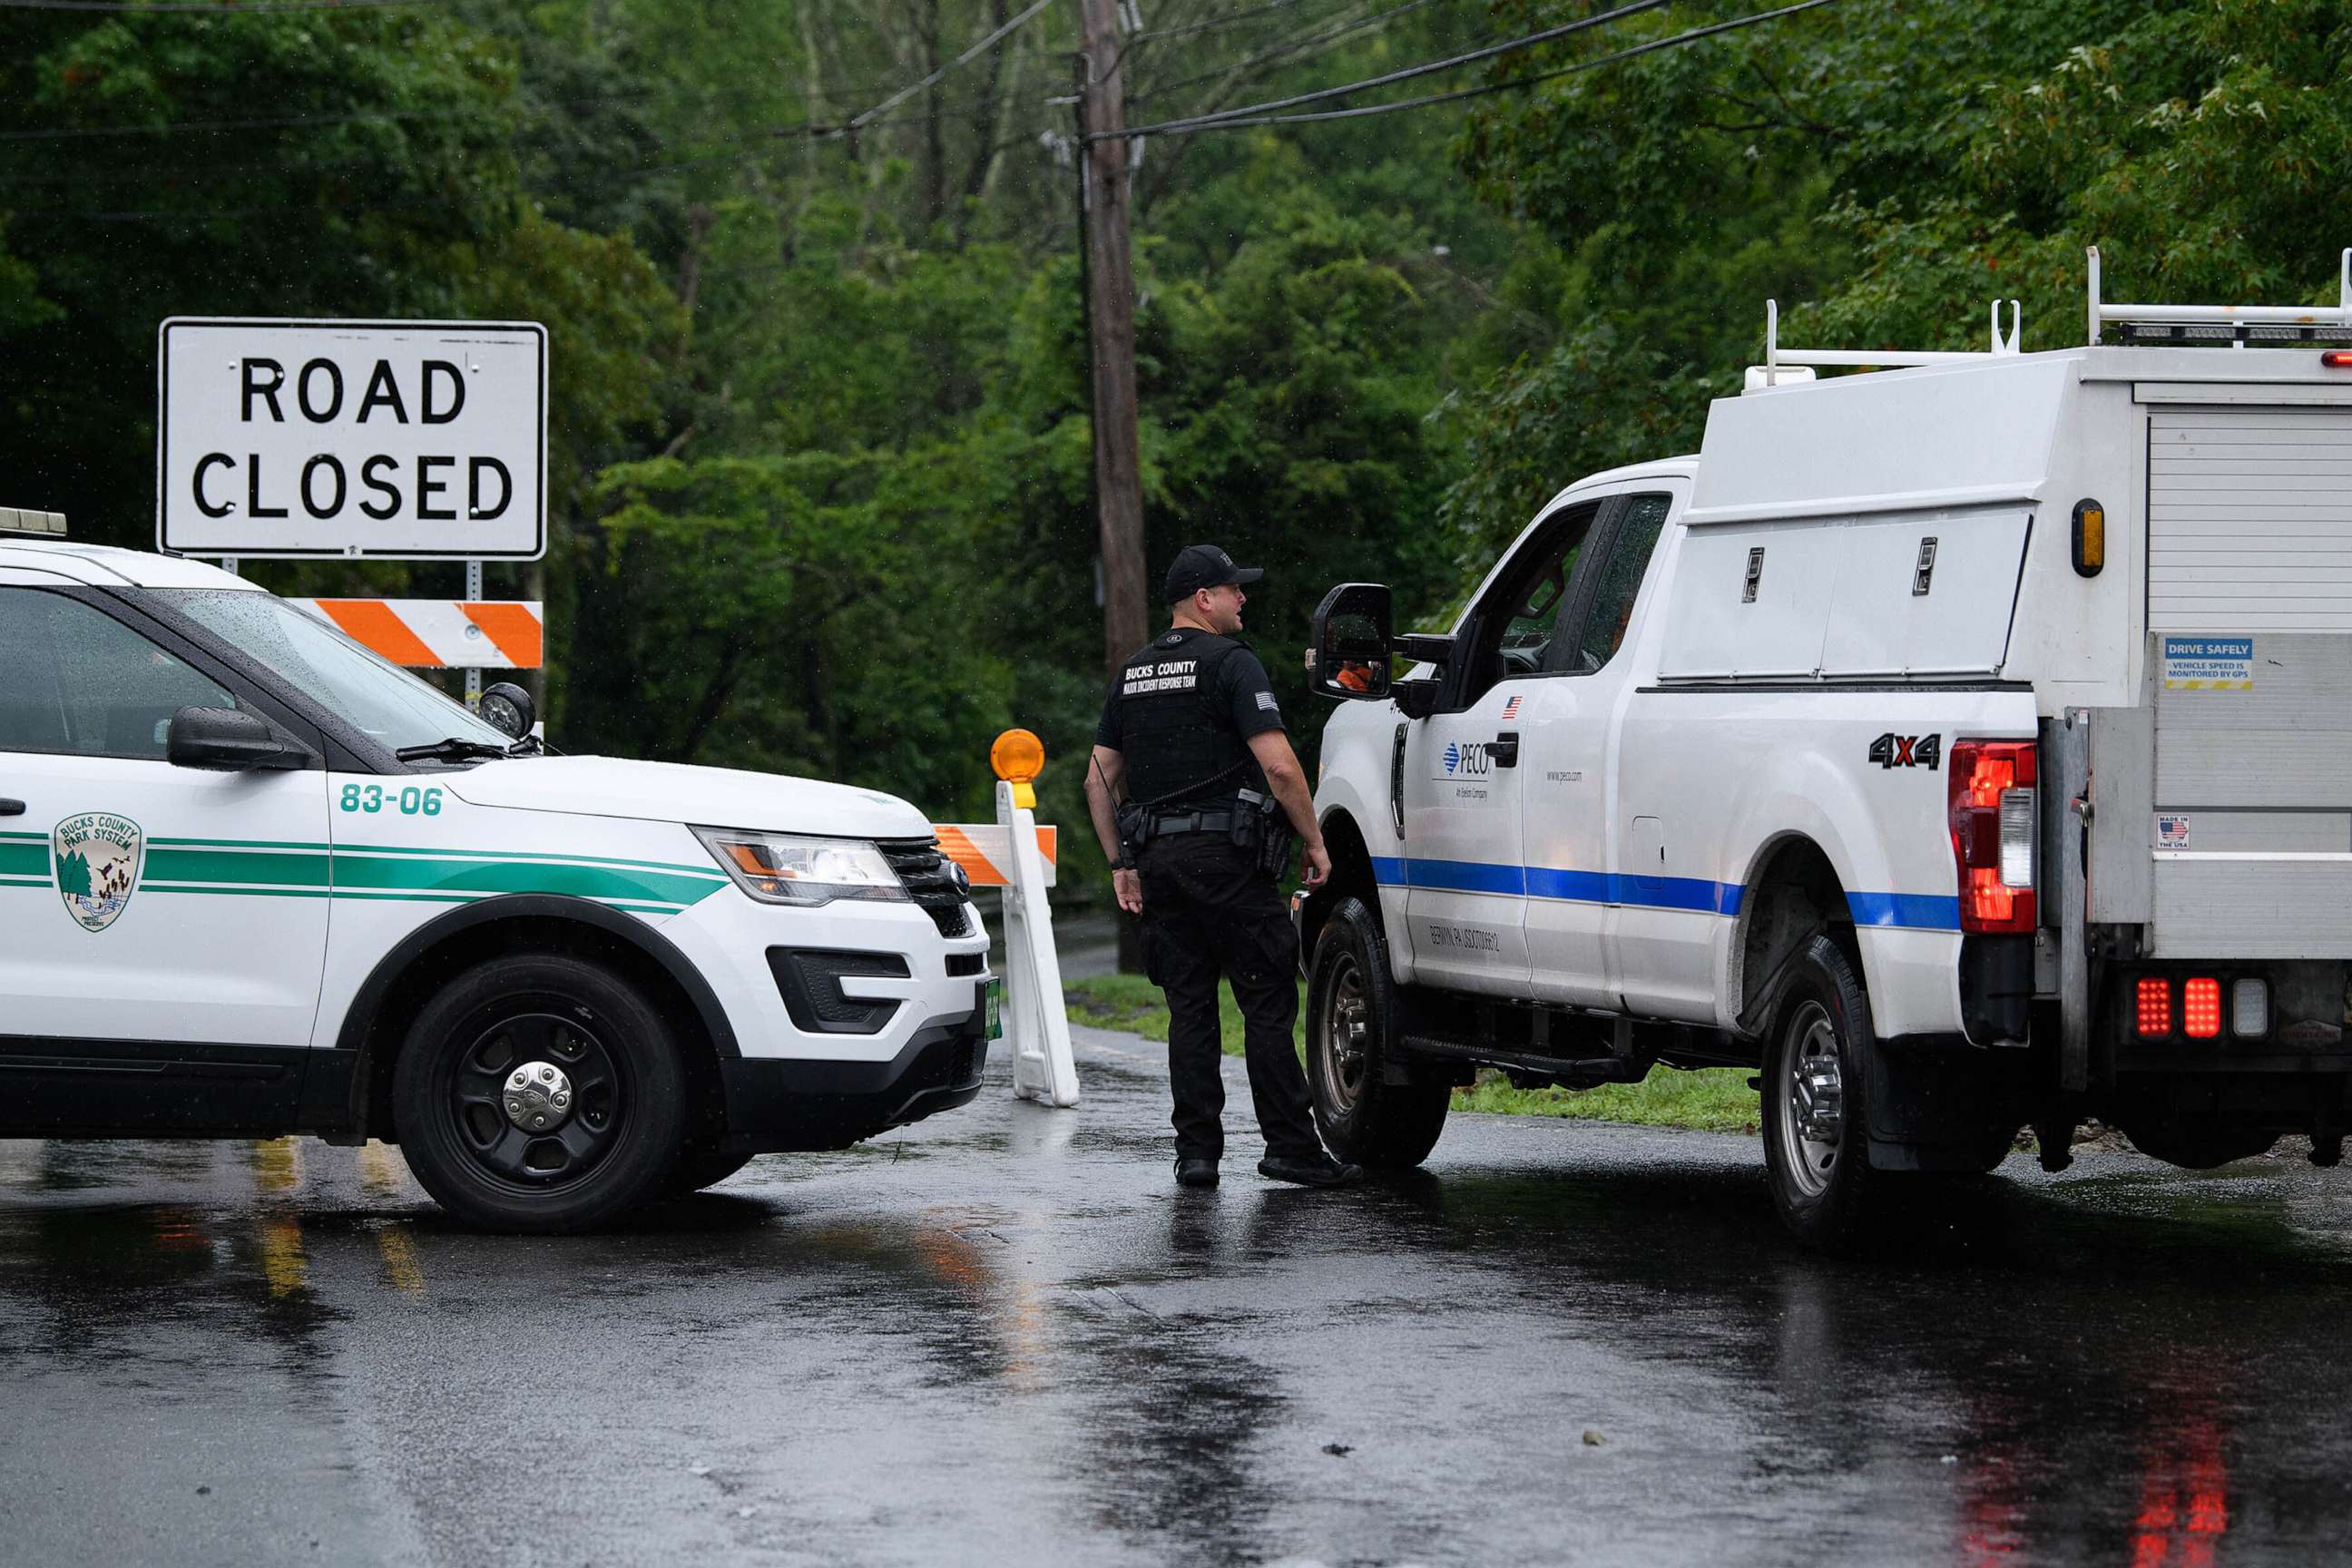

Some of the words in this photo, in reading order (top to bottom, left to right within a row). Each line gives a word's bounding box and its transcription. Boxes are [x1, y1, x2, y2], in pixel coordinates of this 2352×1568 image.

[241, 358, 466, 424] ROAD
[192, 452, 513, 520] CLOSED
[2169, 644, 2204, 654] DRIVE
[2206, 644, 2249, 654] SAFELY
[1125, 665, 1153, 681] BUCKS
[1158, 661, 1197, 675] COUNTY
[2168, 670, 2219, 678] MONITORED
[1137, 679, 1159, 693] INCIDENT
[1159, 676, 1182, 690] RESPONSE
[1182, 675, 1196, 688] TEAM
[1460, 742, 1489, 774] PECO
[340, 783, 443, 816] 83-06
[60, 816, 94, 838] BUCKS
[98, 816, 138, 840] COUNTY
[64, 829, 91, 849] PARK
[93, 828, 132, 851] SYSTEM
